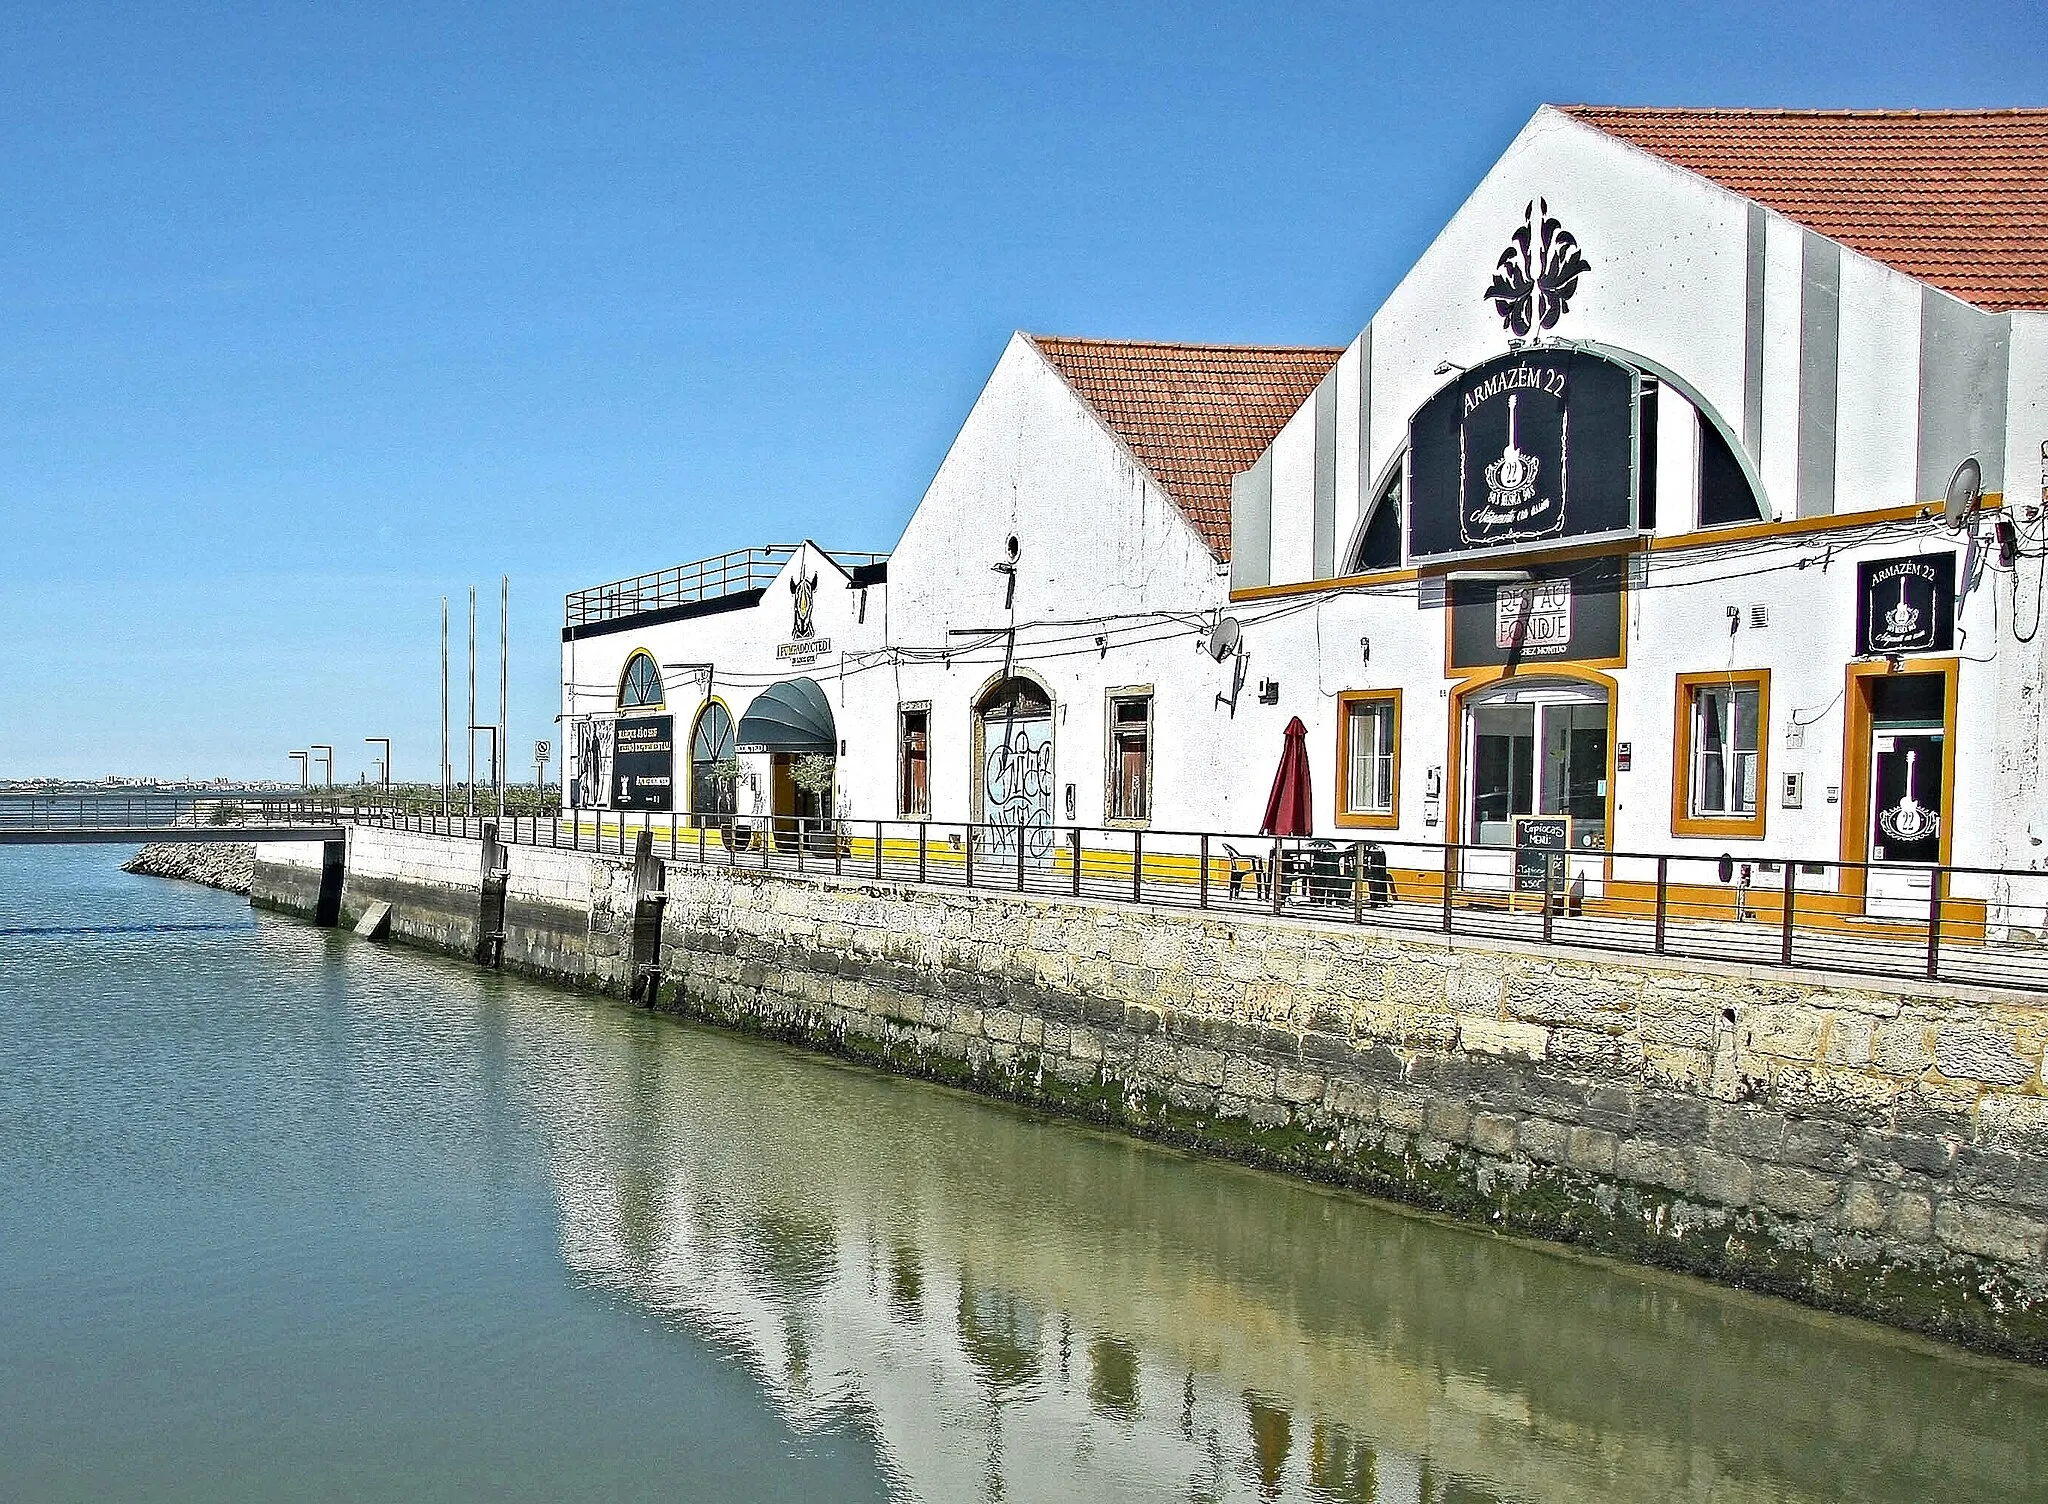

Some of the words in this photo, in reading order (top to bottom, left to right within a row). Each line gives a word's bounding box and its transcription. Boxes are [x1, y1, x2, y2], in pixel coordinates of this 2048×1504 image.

[1463, 360, 1542, 419] ARMAZÉM
[1544, 368, 1565, 399] 22
[1871, 559, 1921, 587] ARMAZÉM
[1921, 564, 1935, 582] 22
[1500, 583, 1566, 613] RESTAU
[1500, 615, 1567, 643] FONDUE
[1902, 811, 1915, 831] 22
